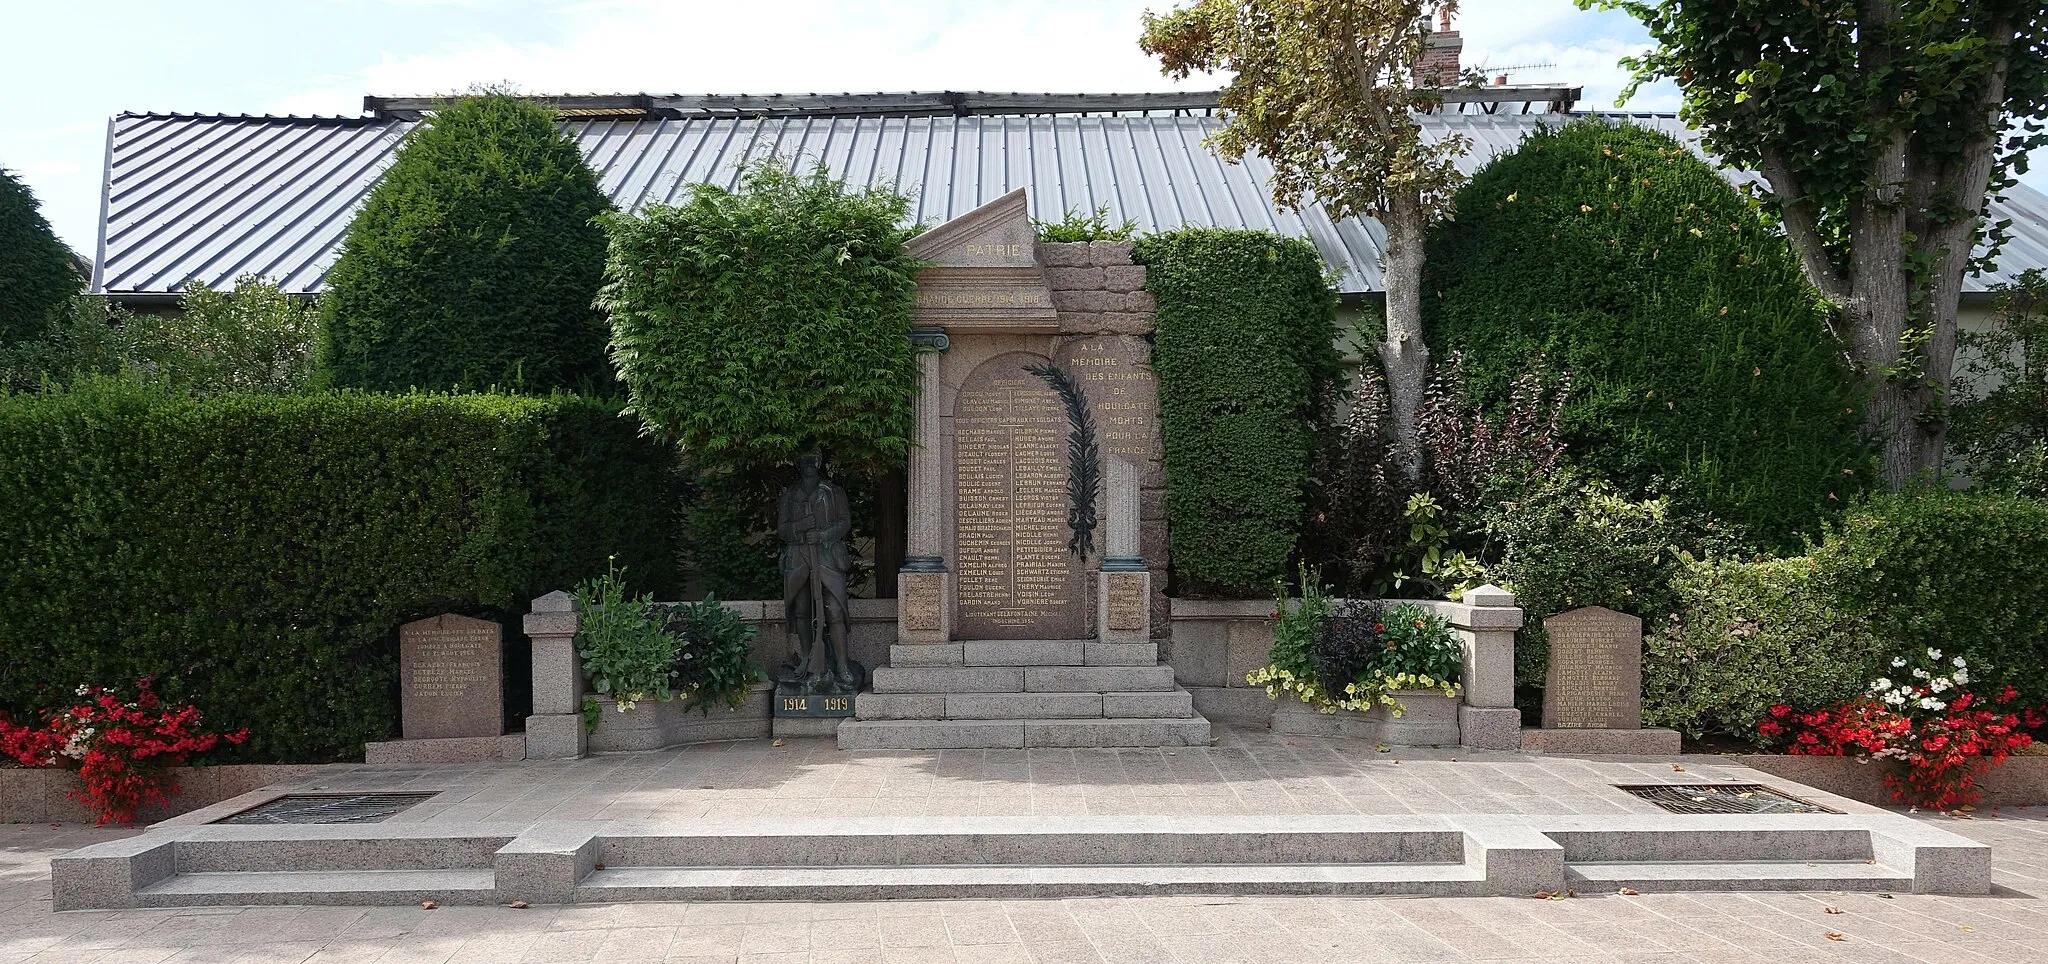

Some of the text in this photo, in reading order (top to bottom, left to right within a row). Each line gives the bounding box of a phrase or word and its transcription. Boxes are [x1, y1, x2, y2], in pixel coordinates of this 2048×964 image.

[966, 244, 1020, 256] PATRIE
[956, 294, 992, 303] GUERRE
[996, 294, 1014, 302] 1914
[1108, 446, 1146, 454] FRANCE
[784, 698, 848, 710] 1914 1919
